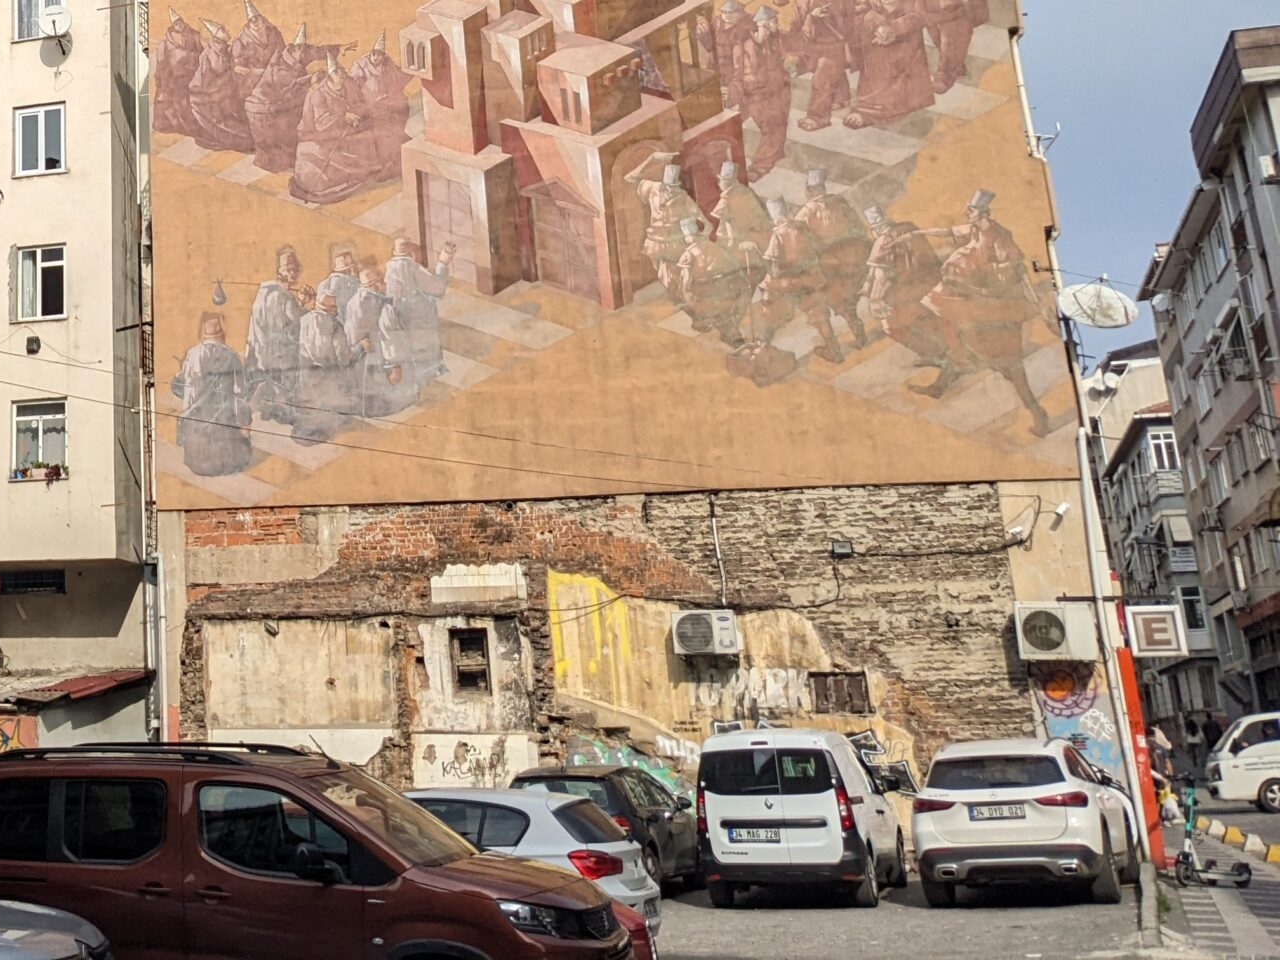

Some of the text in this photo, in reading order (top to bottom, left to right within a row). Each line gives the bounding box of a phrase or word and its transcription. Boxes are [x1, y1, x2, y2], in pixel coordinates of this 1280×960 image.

[1141, 617, 1173, 646] E
[734, 830, 743, 839] 34
[746, 829, 761, 839] MAG
